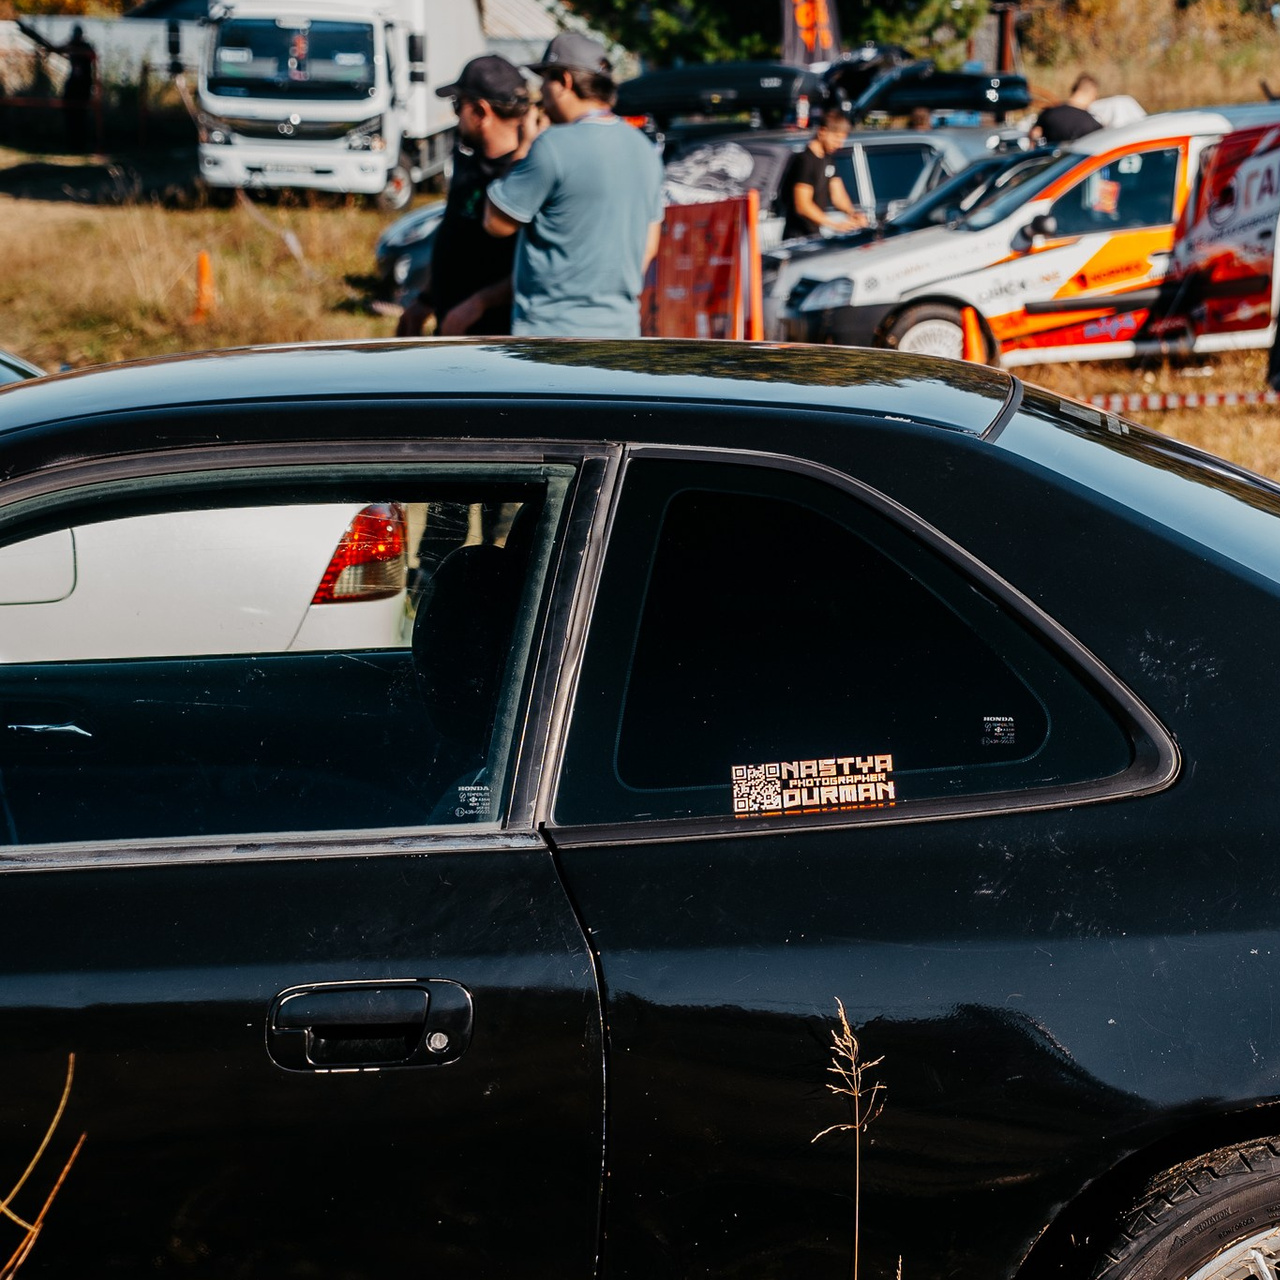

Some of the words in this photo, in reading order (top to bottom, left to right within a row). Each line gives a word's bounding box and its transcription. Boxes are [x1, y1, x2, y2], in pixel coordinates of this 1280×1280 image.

[781, 754, 894, 780] NASTYA
[789, 773, 887, 788] PHOTOGRAPHER
[783, 781, 896, 809] DURMAN
